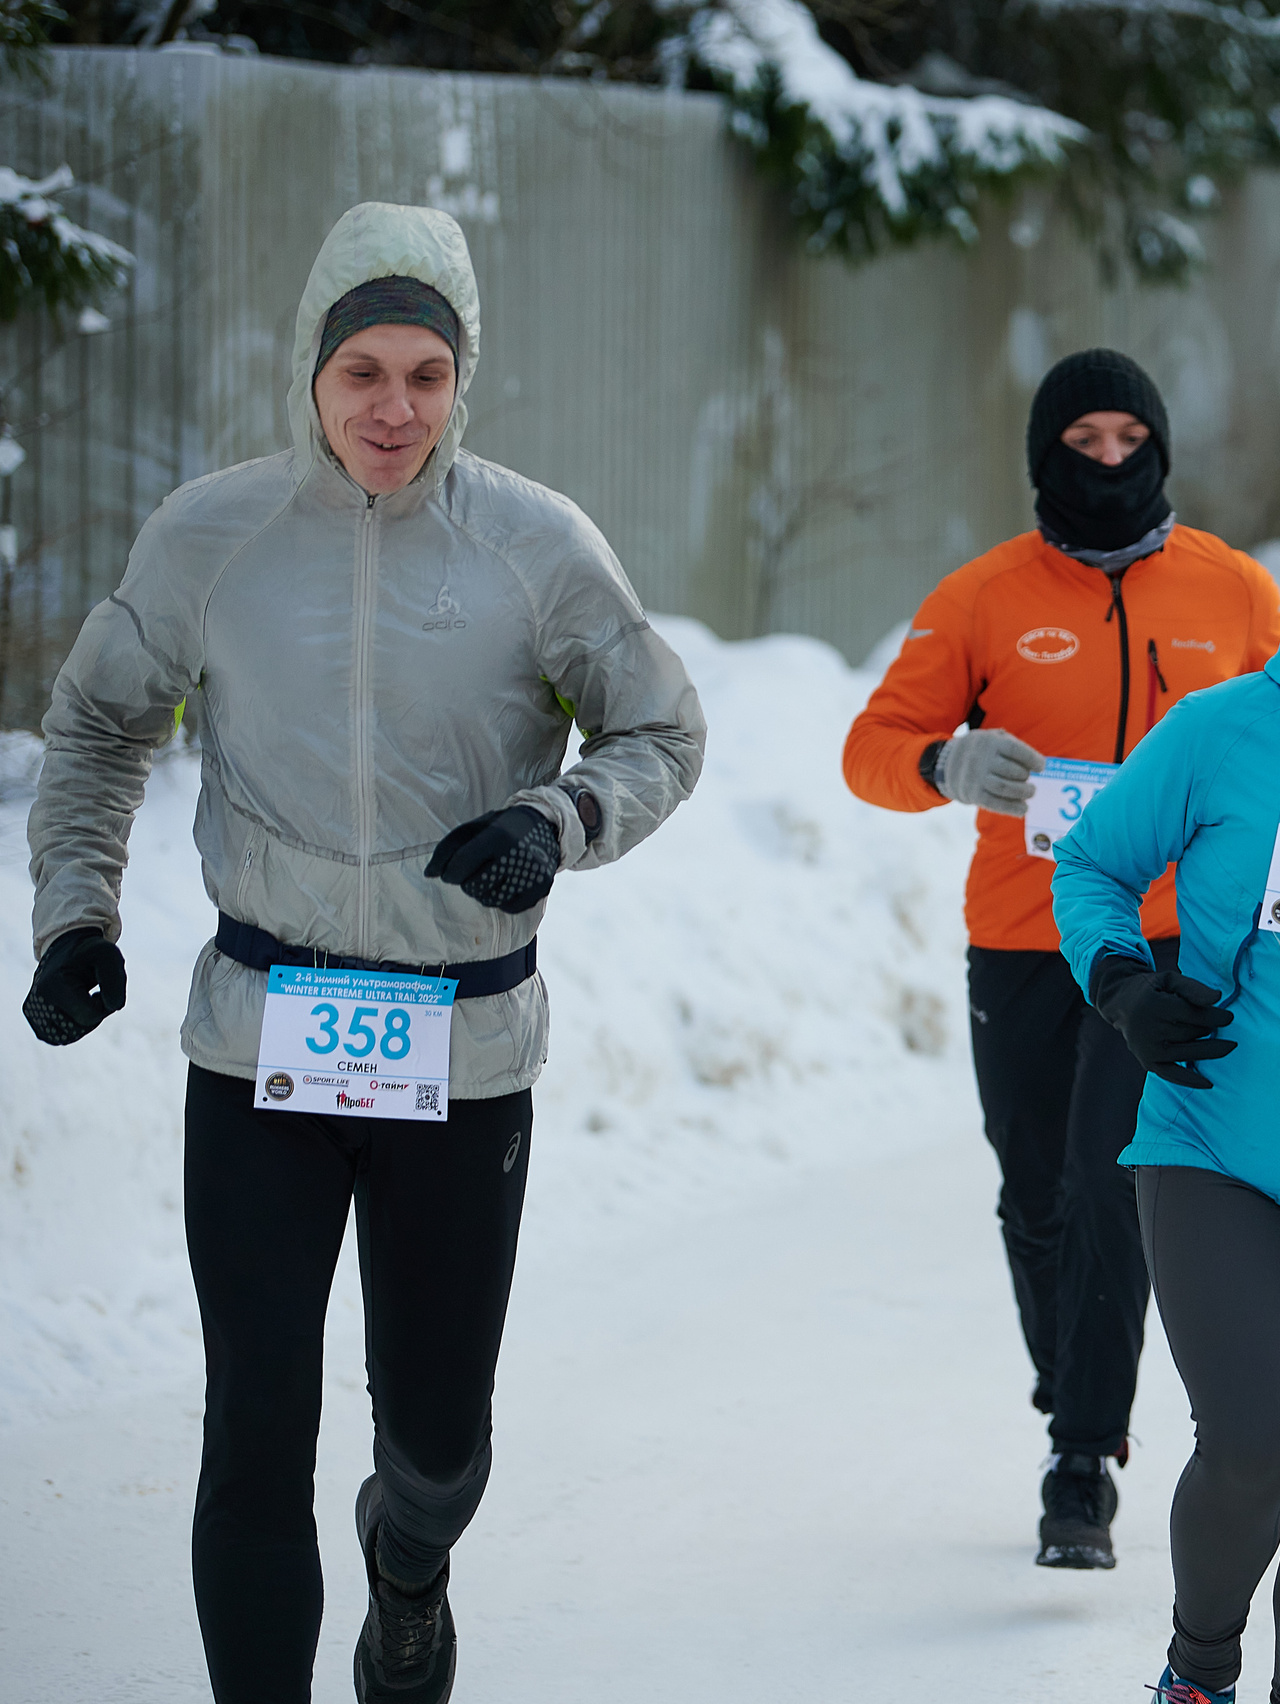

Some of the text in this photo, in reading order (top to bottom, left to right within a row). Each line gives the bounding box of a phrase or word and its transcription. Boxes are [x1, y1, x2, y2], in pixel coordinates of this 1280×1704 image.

[295, 973, 433, 993] 2-й зимний ультрамарафон
[281, 984, 318, 996] "WINTER
[321, 986, 363, 999] EXTREME
[365, 989, 392, 1001] ULTRA
[394, 991, 416, 1003] TRAIL
[305, 1002, 411, 1060] 358
[337, 1061, 378, 1073] СЕМЕН
[313, 1076, 335, 1084] SPORT
